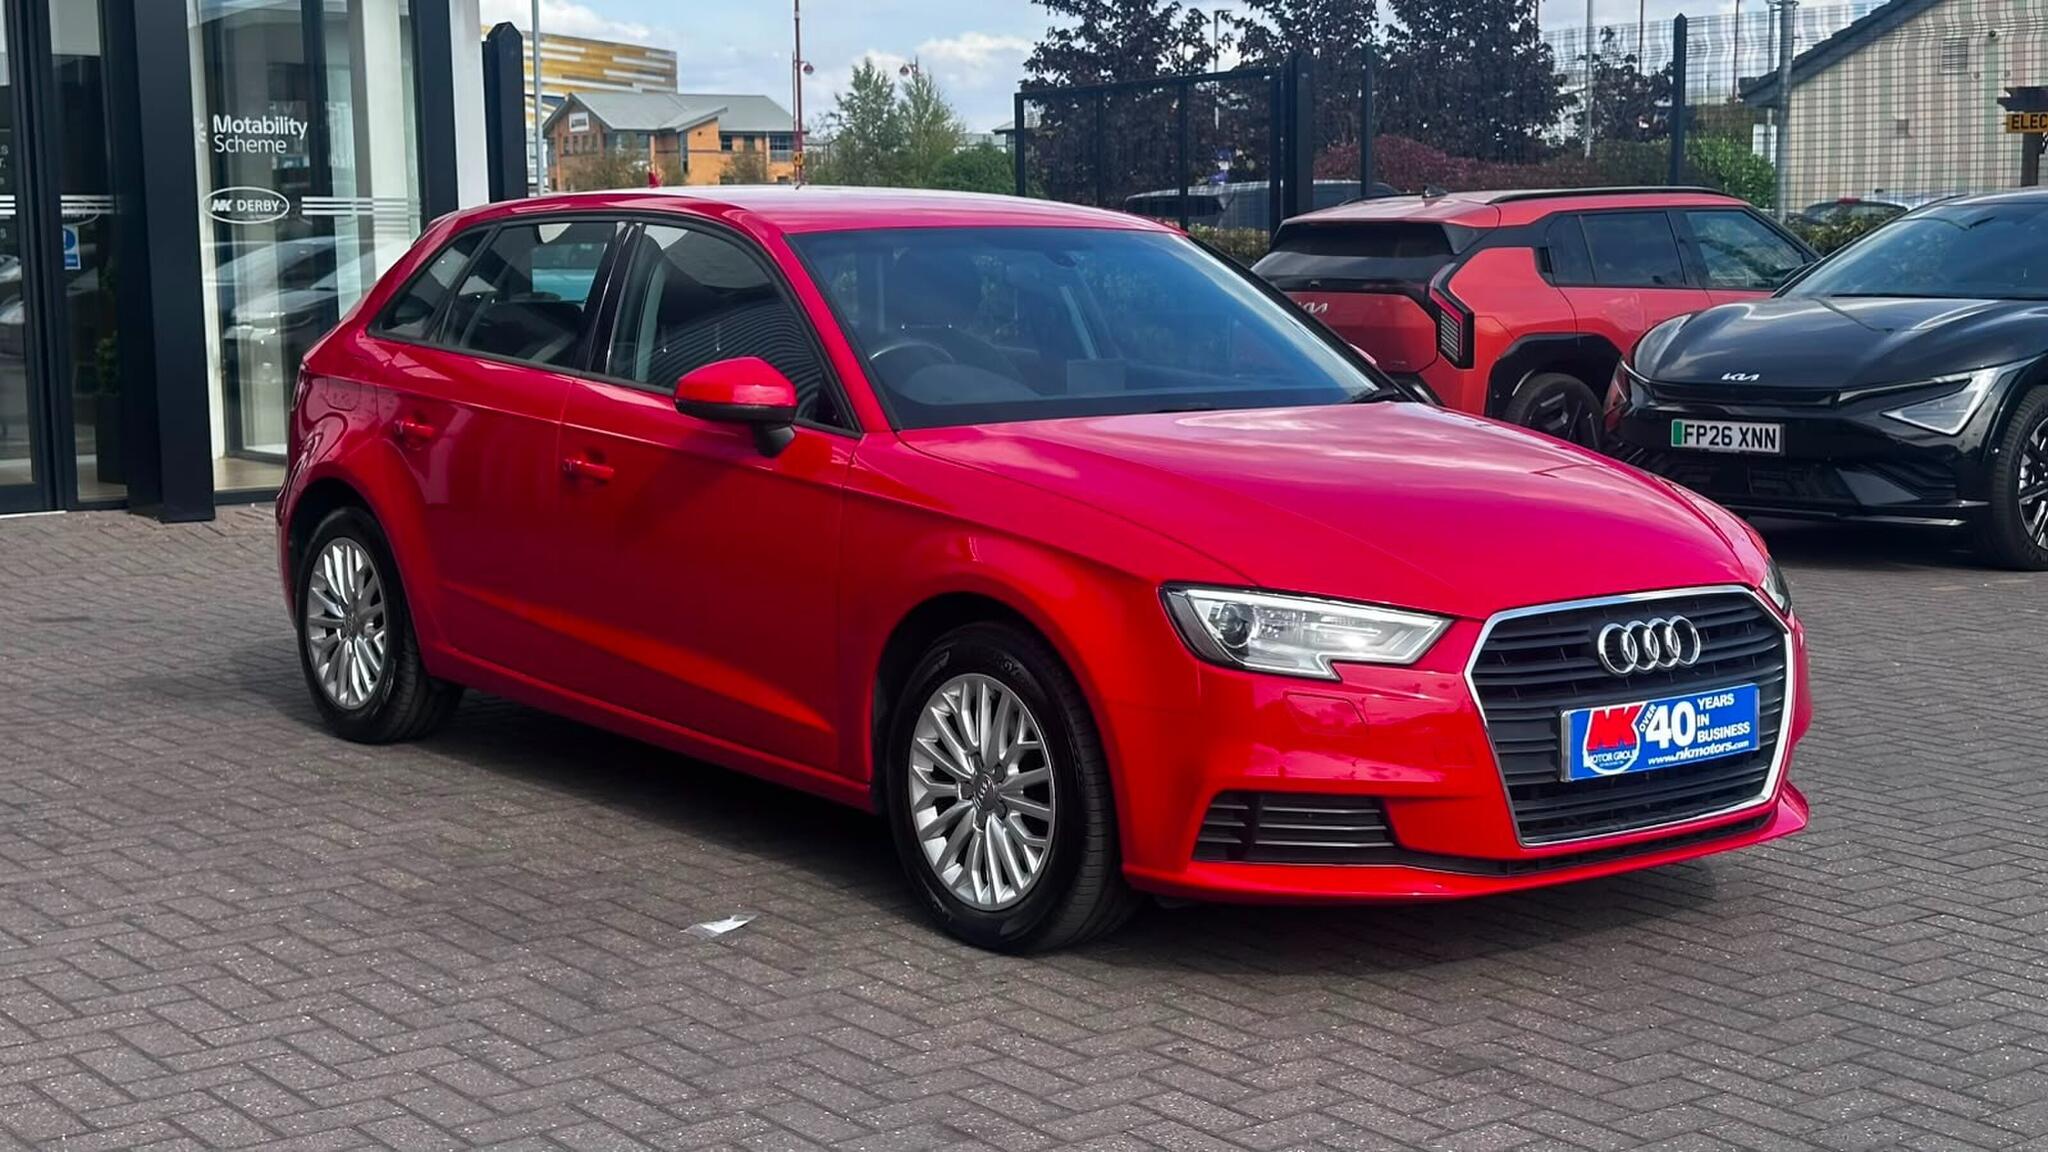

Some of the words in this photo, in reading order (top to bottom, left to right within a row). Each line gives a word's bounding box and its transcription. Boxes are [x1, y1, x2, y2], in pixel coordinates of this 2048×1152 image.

[213, 114, 308, 140] Motability
[214, 134, 287, 154] Scheme
[211, 199, 232, 212] NK
[236, 199, 280, 212] DERBY
[1683, 424, 1733, 447] FP26
[1738, 427, 1777, 449] XNN
[1697, 693, 1735, 711] YEARS
[1639, 704, 1656, 732] OVER
[1645, 701, 1696, 749] 40
[1697, 714, 1710, 727] IN
[1697, 722, 1750, 743] BUSINESS
[1648, 740, 1750, 765] www.nkmotors.com
